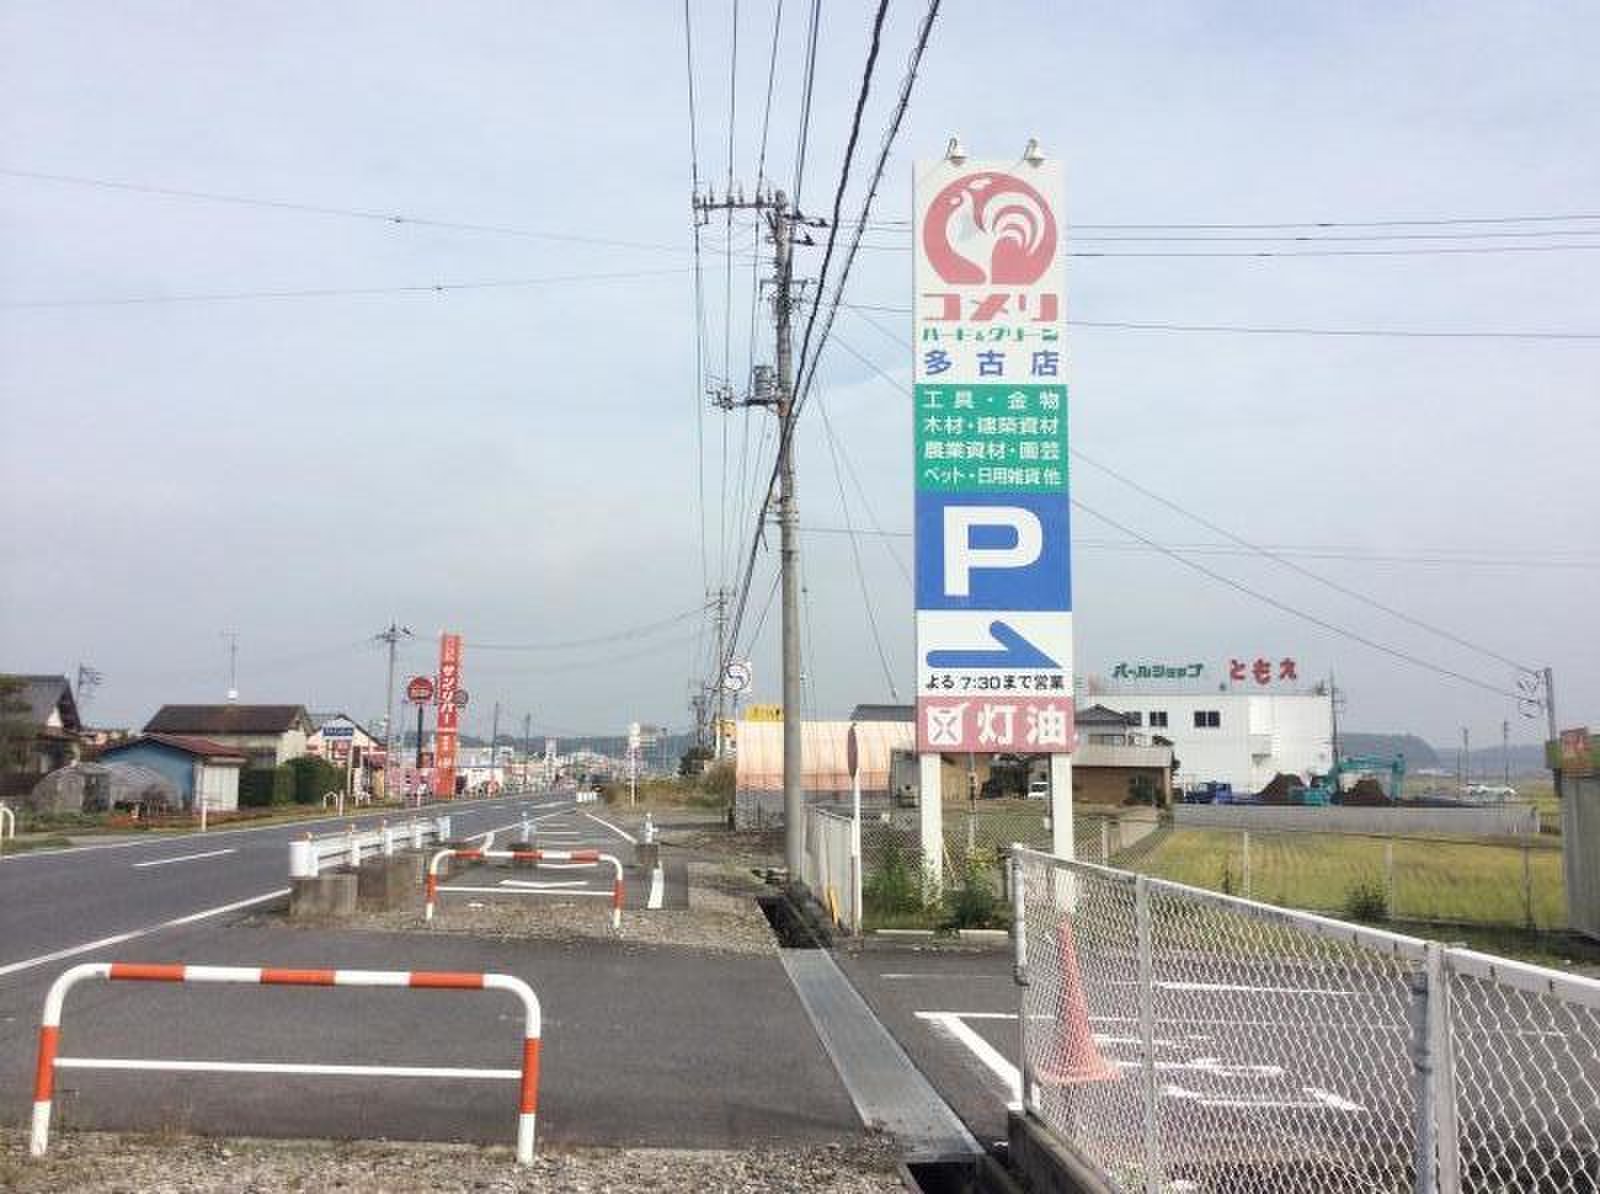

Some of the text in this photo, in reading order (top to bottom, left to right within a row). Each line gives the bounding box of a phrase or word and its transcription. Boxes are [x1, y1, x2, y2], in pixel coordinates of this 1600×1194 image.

[922, 293, 1059, 322] コメリ
[924, 349, 1060, 377] 多古店
[944, 506, 1043, 597] P
[1229, 657, 1297, 685] ともえ
[976, 702, 1068, 746] 灯油
